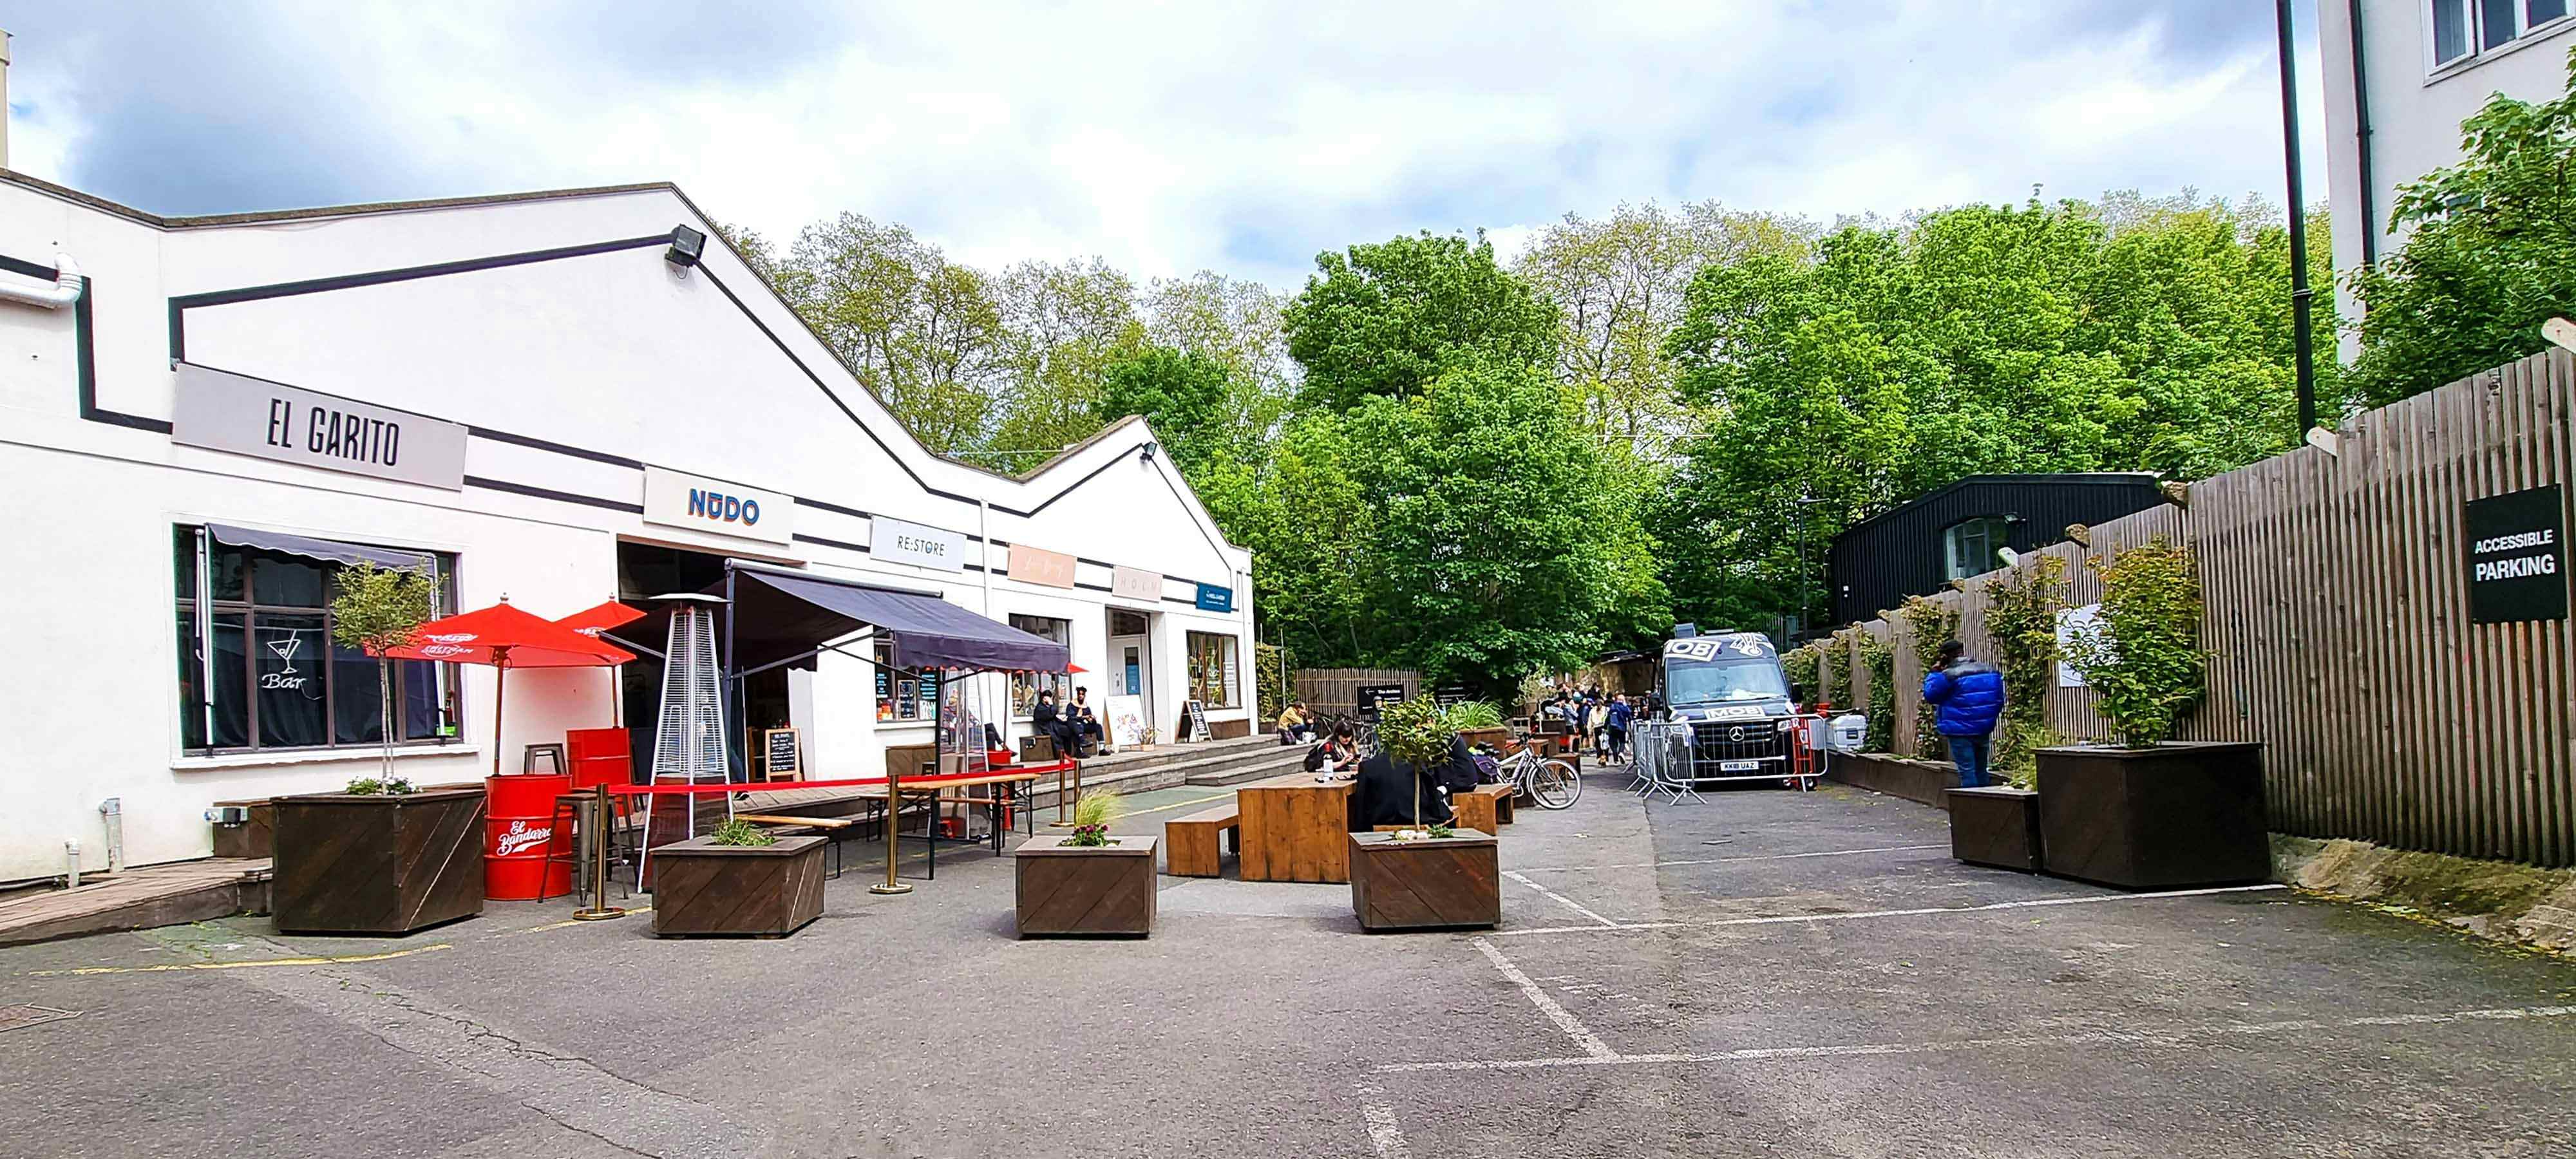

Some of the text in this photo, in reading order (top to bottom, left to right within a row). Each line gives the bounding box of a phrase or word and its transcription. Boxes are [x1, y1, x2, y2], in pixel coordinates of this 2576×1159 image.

[267, 397, 400, 467] EL GARITO
[897, 535, 945, 556] RE:STORE
[2474, 529, 2554, 554] ACCESSIBLE
[2475, 554, 2555, 581] PARKING
[261, 673, 307, 690] Bar
[1710, 707, 1759, 717] MOB
[510, 820, 526, 835] El
